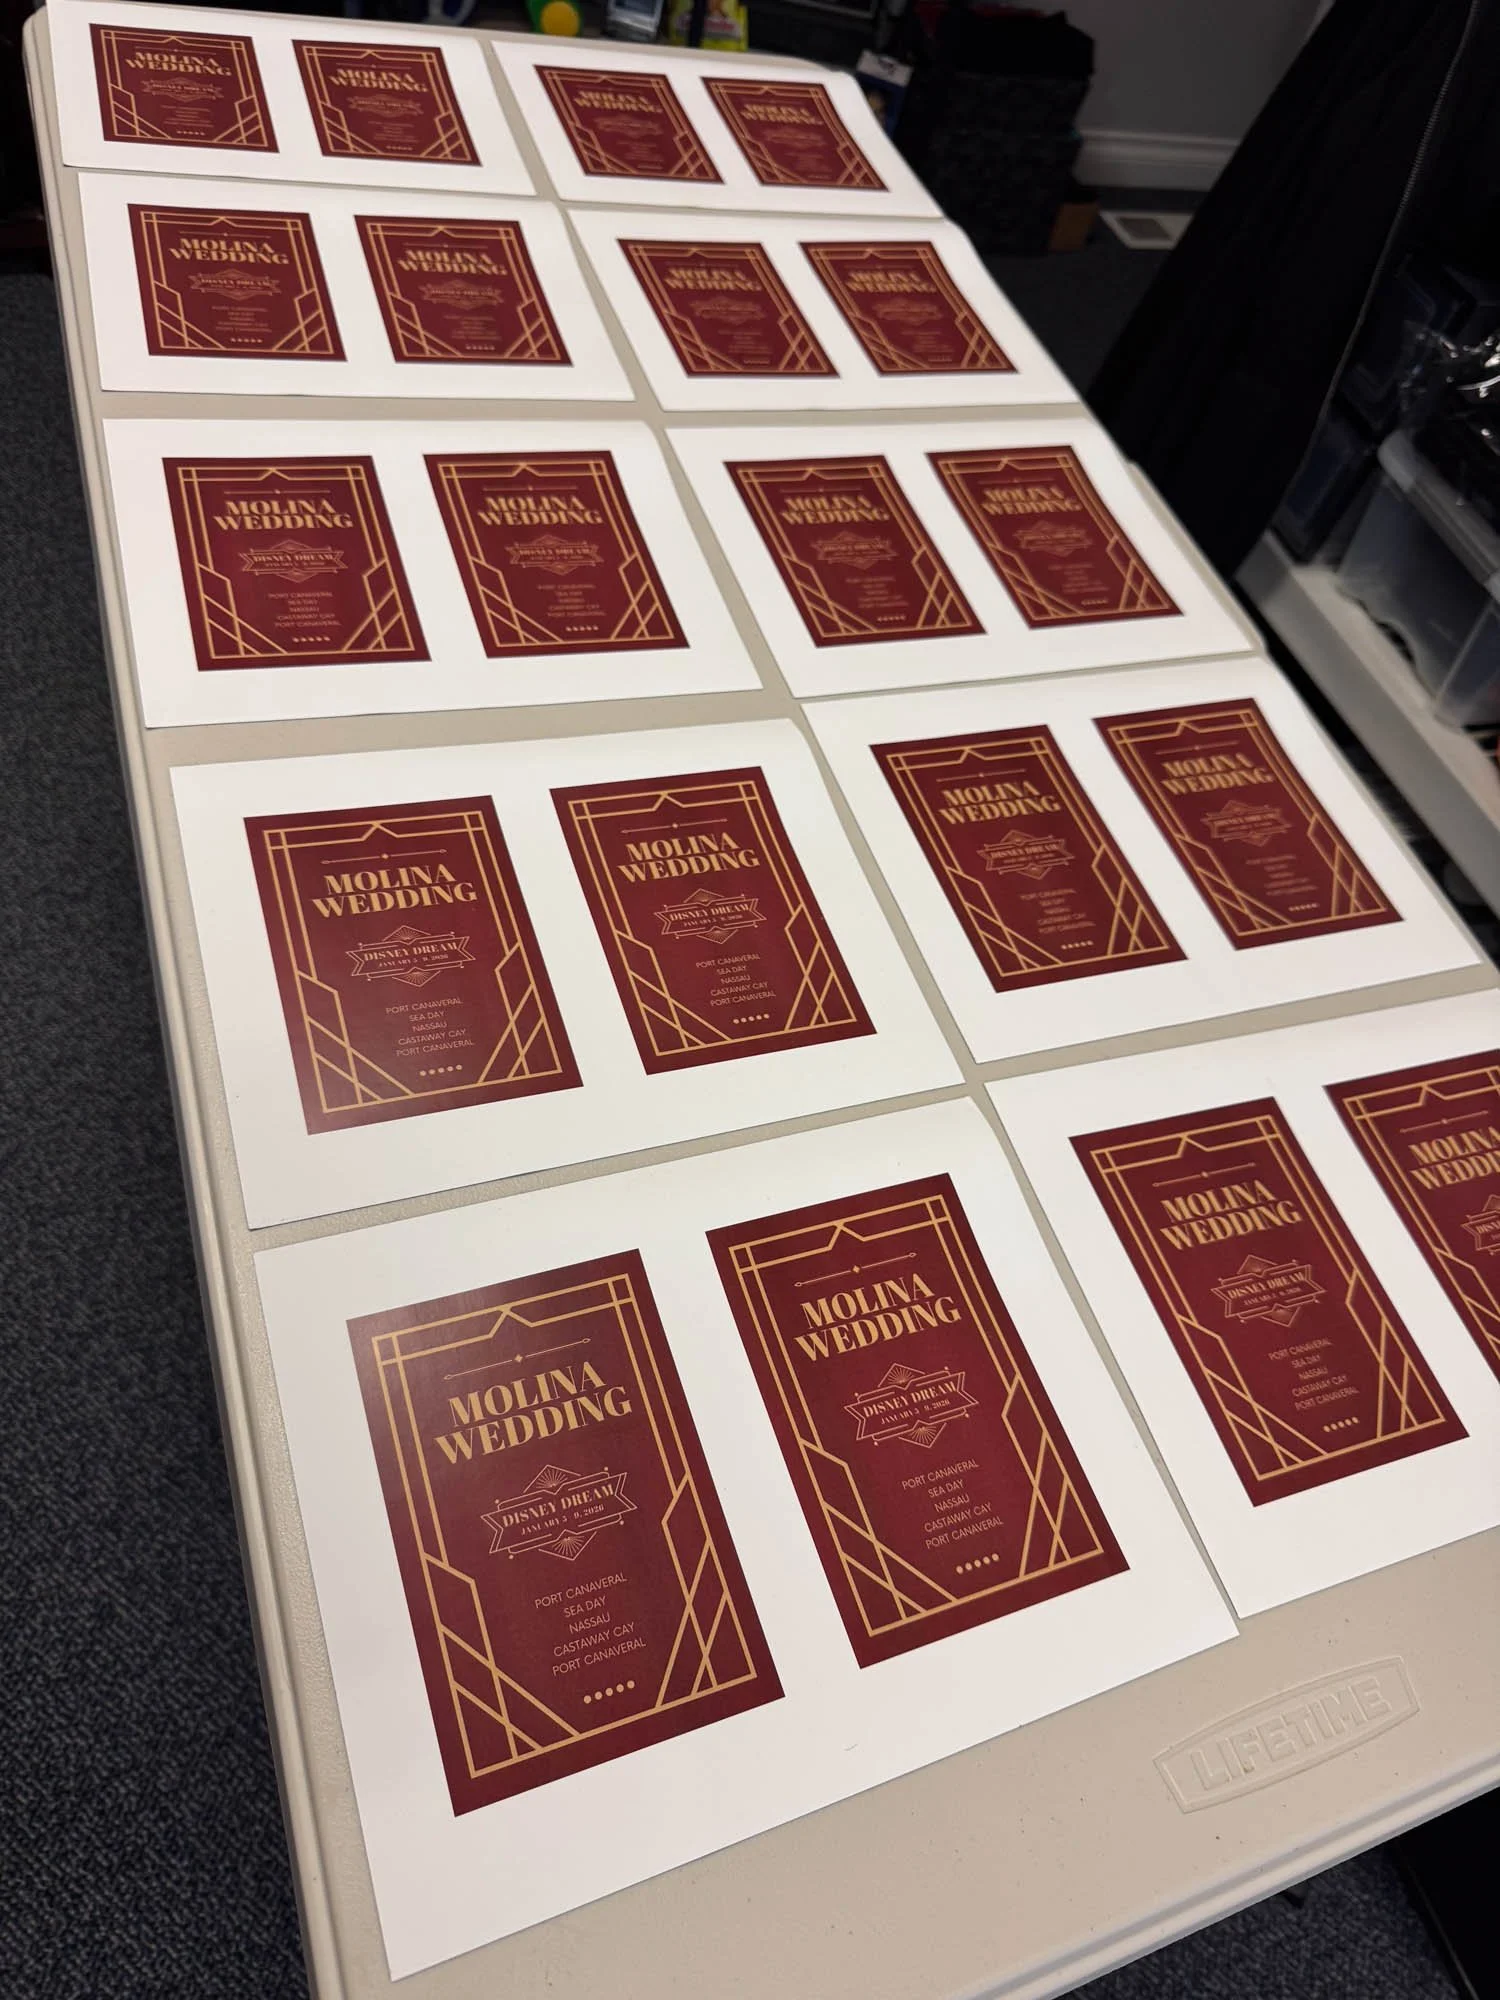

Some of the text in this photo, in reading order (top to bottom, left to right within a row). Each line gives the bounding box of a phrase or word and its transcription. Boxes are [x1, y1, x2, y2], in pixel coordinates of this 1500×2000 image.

[123, 58, 231, 75] WEDDING
[134, 51, 220, 66] MOLINA
[327, 75, 427, 90] WEDDING
[335, 67, 416, 81] MOLINA
[179, 237, 276, 253] MOLINA
[167, 247, 288, 264] WEDDING
[404, 249, 494, 262] MOLINA
[395, 259, 507, 273] WEDDING
[224, 499, 337, 515] MOLINA
[484, 494, 586, 510] MOLINA
[784, 495, 873, 511] MOLINA
[212, 513, 353, 530] WEDDING
[475, 508, 602, 525] WEDDING
[779, 507, 889, 524] WEDDING
[1161, 752, 1253, 777] MOLINA
[1160, 766, 1273, 795] WEDDING
[941, 780, 1041, 806] MOLINA
[937, 794, 1061, 824] WEDDING
[624, 830, 740, 861] MOLINA
[616, 847, 760, 882] WEDDING
[323, 863, 457, 895] MOLINA
[309, 881, 477, 918] WEDDING
[668, 903, 749, 921] DISNEY DREAM
[363, 941, 457, 961] DISNEY DREAM
[695, 953, 761, 968] PORT CANAVERAL
[716, 965, 746, 976] SEA DAY
[720, 974, 750, 985] NASSAU
[710, 981, 767, 997] CASTAWAY CAY
[710, 991, 776, 1007] PORT CANAVERAL
[385, 997, 463, 1014] PORT CANAVERAL
[408, 1010, 444, 1022] SEA DAY
[412, 1020, 447, 1032] NASSAU
[398, 1028, 466, 1045] CASTAWAY CAY
[396, 1038, 475, 1057] PORT CANAVERAL
[1409, 1151, 1500, 1190] WEDDI
[1161, 1179, 1276, 1223] MOLINA
[1158, 1199, 1302, 1250] WEDDING
[1226, 1282, 1265, 1300] DISNEY
[1266, 1272, 1305, 1289] DREAM
[800, 1272, 935, 1329] MOLINA
[792, 1294, 962, 1361] WEDDING
[1268, 1348, 1288, 1361] PORT
[447, 1361, 606, 1428] MOLINA
[862, 1380, 956, 1417] DISNEY DREAM
[433, 1386, 632, 1464] WEDDING
[901, 1458, 979, 1489] PORT CANAVERAL
[927, 1478, 963, 1498] SEA DAY
[502, 1483, 614, 1527] DISNEY DREAM
[934, 1493, 969, 1512] NASSAU
[924, 1502, 991, 1532] CASTAWAY CAY
[925, 1516, 1004, 1549] PORT CANAVERAL
[534, 1572, 627, 1608] PORT CANAVERAL
[563, 1595, 606, 1618] SEA DAY
[568, 1611, 610, 1634] NASSAU
[553, 1621, 634, 1657] CASTAWAY CAY
[552, 1636, 646, 1676] PORT CANAVERAL
[1190, 1676, 1392, 1791] LIFETIME
